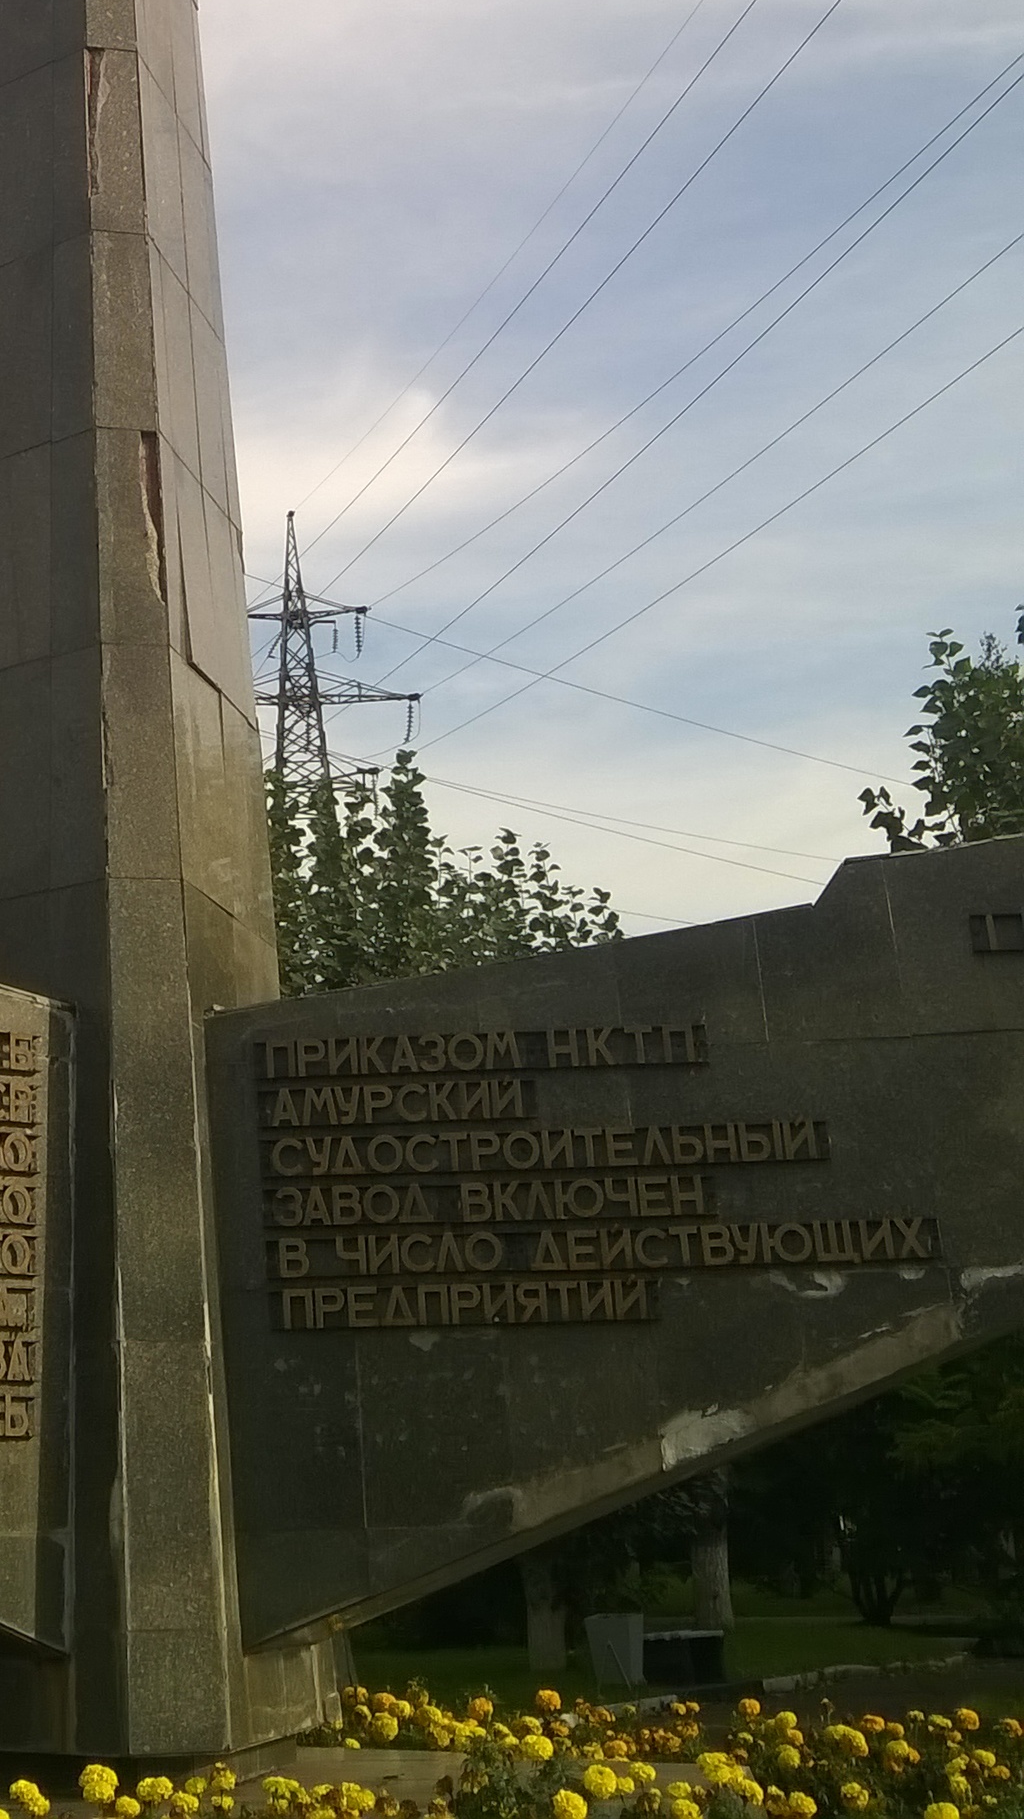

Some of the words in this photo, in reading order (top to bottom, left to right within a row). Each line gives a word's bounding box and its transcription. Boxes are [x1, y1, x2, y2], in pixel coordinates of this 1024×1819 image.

[266, 1031, 522, 1079] ПРИКАЗОМ
[545, 1027, 696, 1068] НКТП
[271, 1074, 524, 1128] АМУРСКИЙ
[271, 1114, 818, 1177] СУДОСТРОИТЕЛЬНЫЙ
[276, 1183, 434, 1227] ЗАВОД
[460, 1173, 705, 1223] ВКЛЮЧЕН
[279, 1236, 310, 1278] В
[335, 1230, 504, 1275] ЧИСЛО
[530, 1215, 931, 1272] ДЕЙСТВУЮЩИХ
[282, 1274, 650, 1330] ПРЕДПРИЯТИЙ
